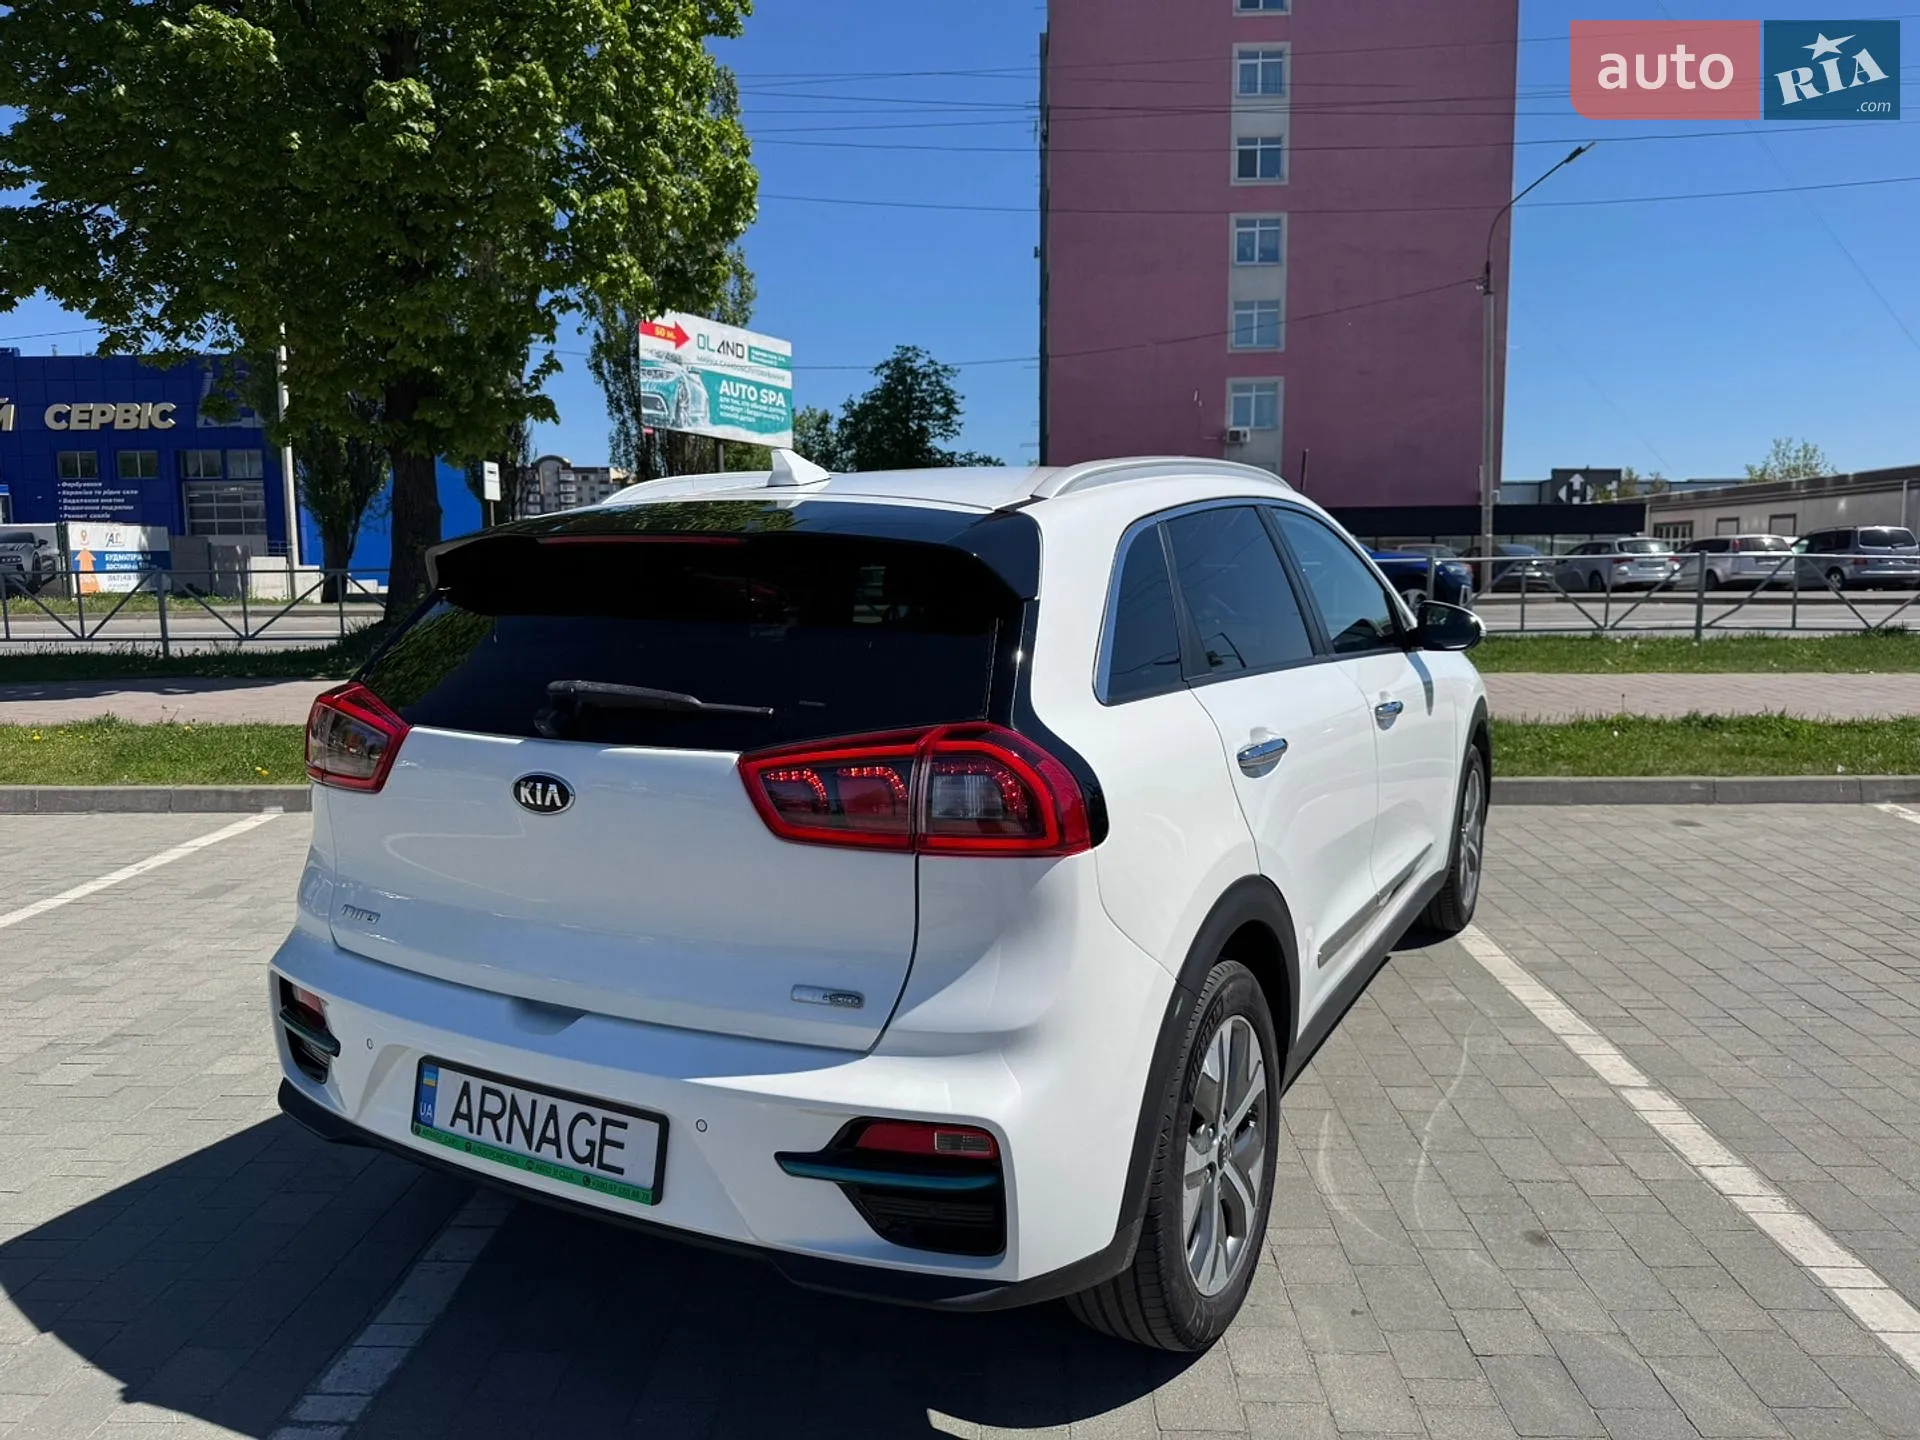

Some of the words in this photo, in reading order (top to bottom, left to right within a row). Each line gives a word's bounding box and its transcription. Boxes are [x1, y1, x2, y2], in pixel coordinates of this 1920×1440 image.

[719, 379, 758, 402] AUTO
[759, 388, 787, 408] SPA
[44, 402, 177, 431] СЕРВІС
[519, 780, 563, 807] KIA
[419, 1101, 433, 1118] UA
[449, 1080, 629, 1177] ARNAGE
